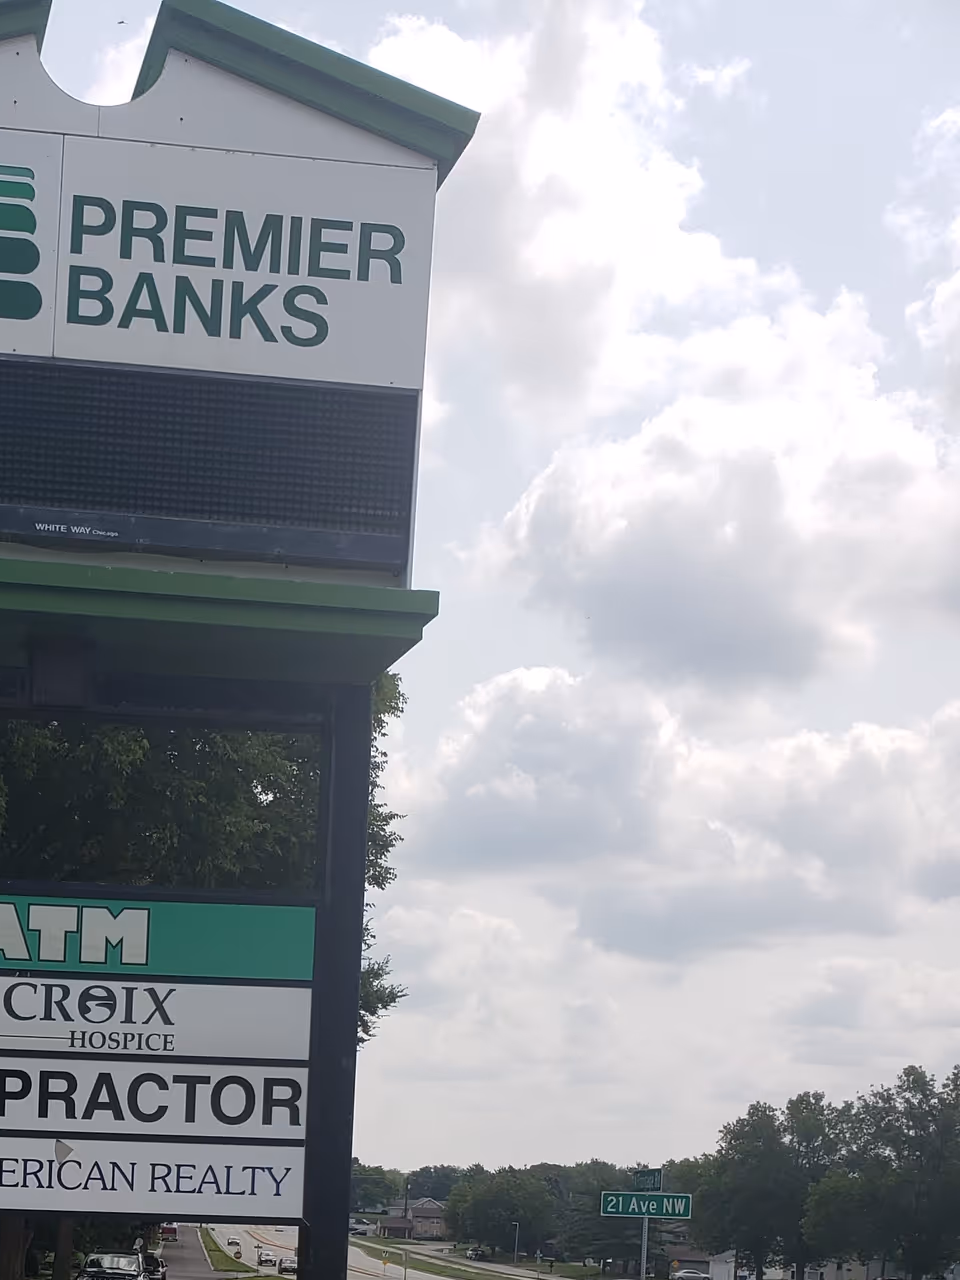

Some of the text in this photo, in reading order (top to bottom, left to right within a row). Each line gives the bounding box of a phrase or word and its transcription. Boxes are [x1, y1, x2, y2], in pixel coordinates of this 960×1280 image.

[69, 194, 406, 285] PREMIER
[66, 264, 329, 348] BANKS
[35, 522, 119, 537] WHITE WAY Chicago
[3, 981, 177, 1026] CROIX
[69, 1030, 176, 1052] HOSPICE
[148, 1162, 293, 1197] REALTY
[606, 1196, 686, 1214] 21 Ave NW
